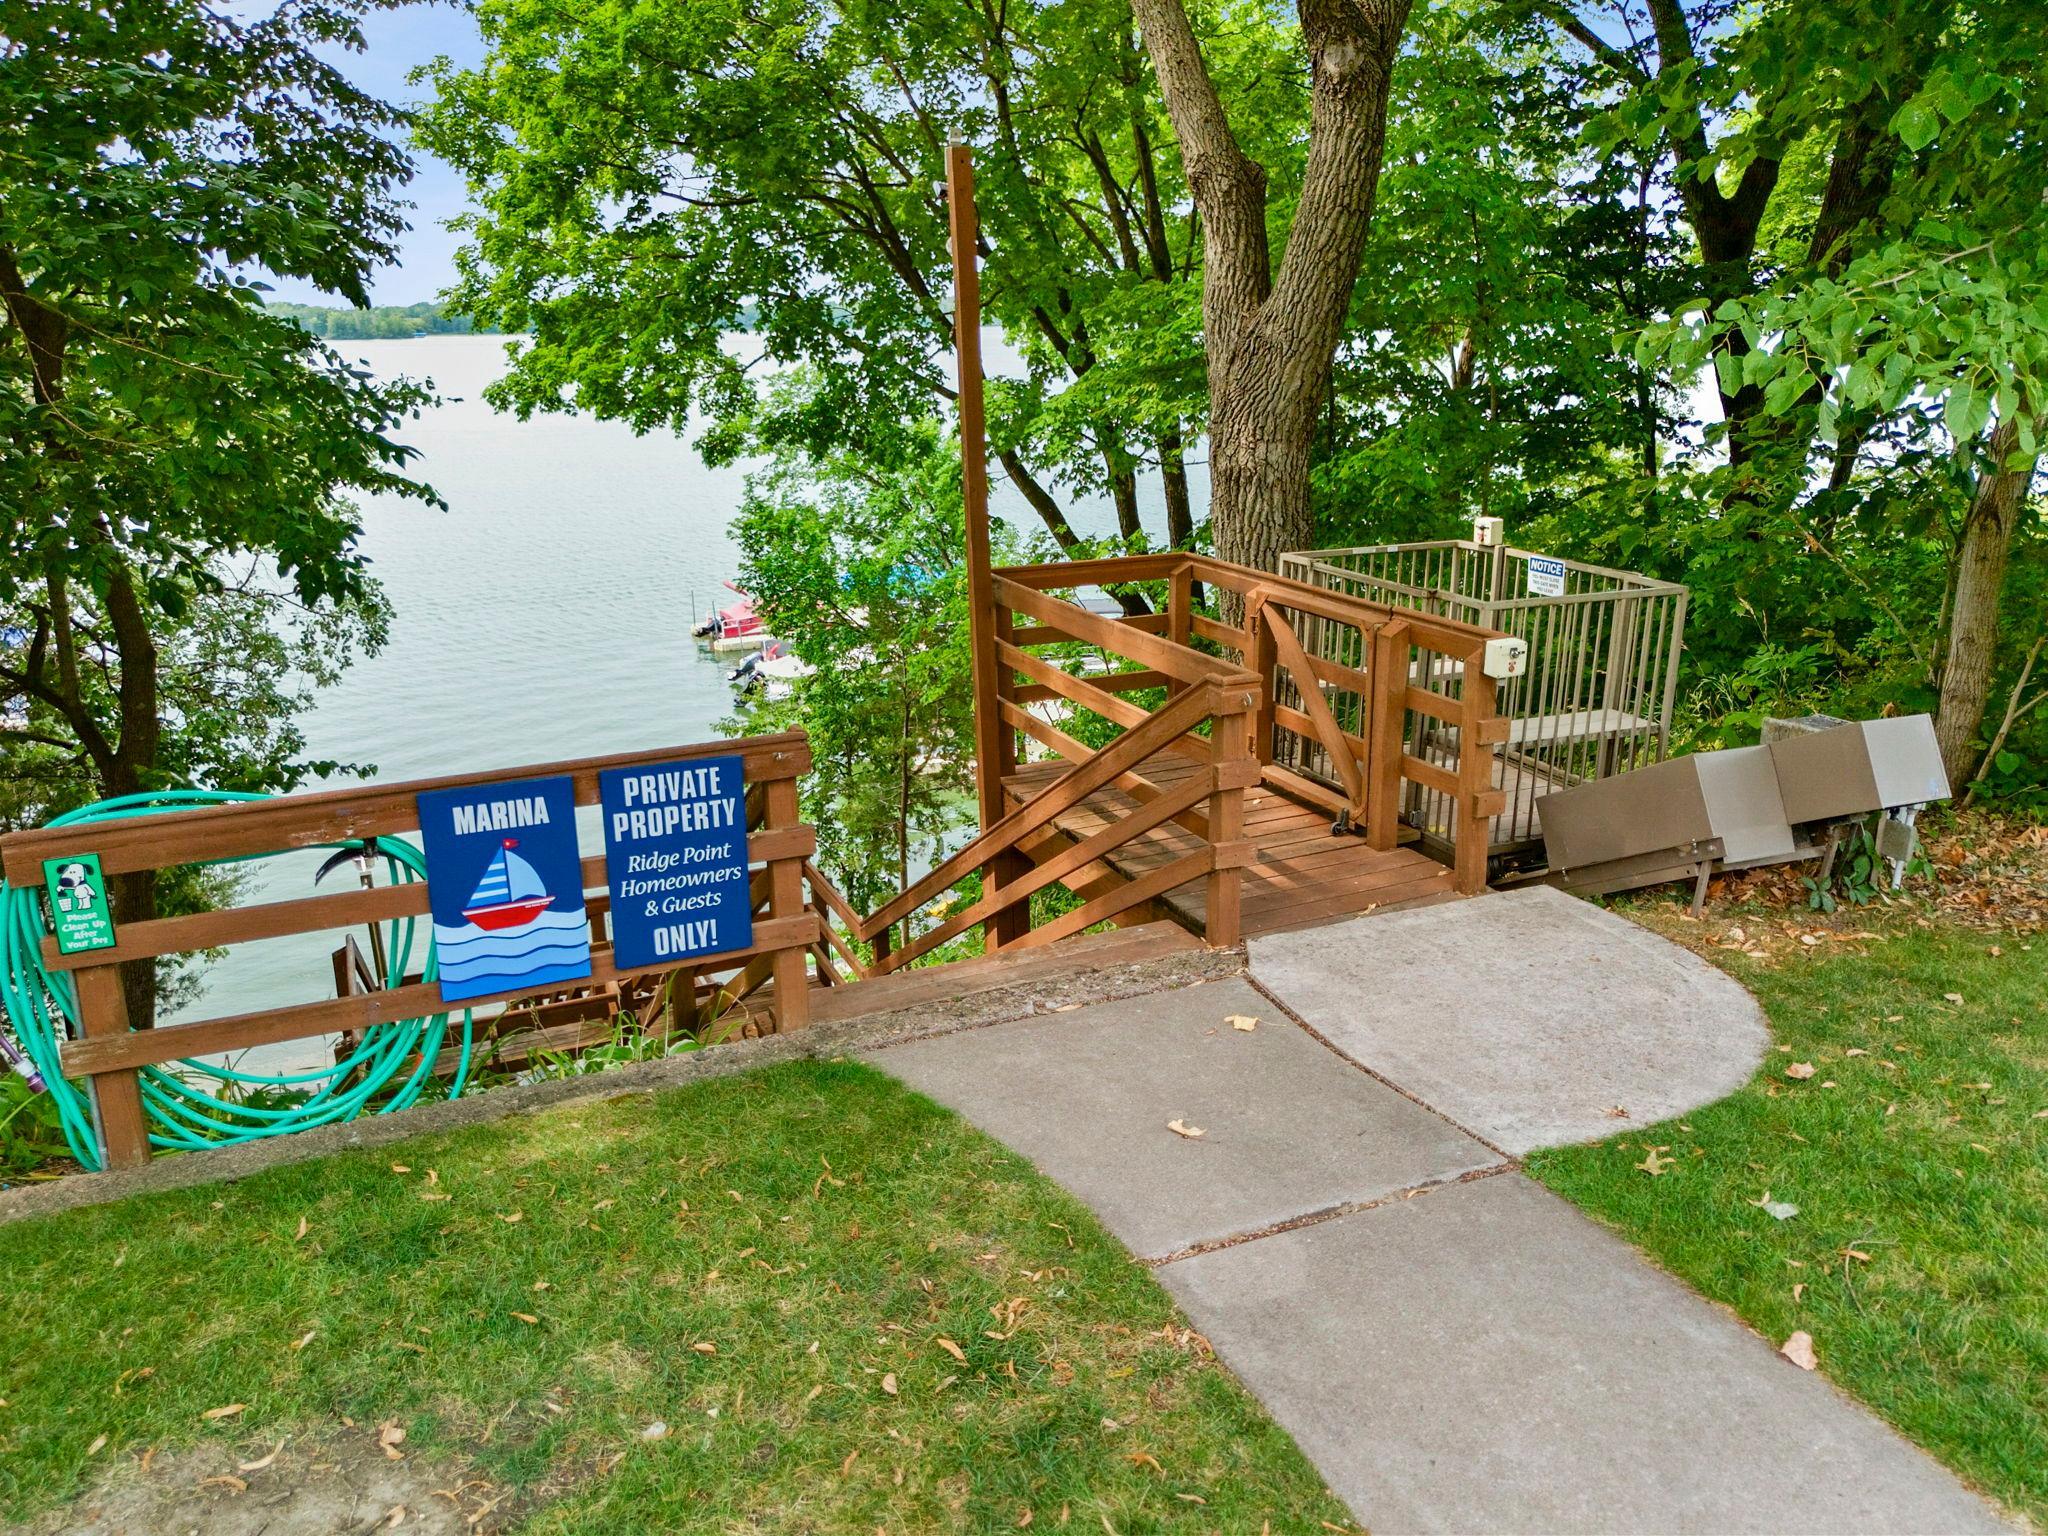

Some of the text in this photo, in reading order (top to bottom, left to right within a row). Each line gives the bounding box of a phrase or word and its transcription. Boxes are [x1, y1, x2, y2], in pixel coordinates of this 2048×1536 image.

[1531, 559, 1562, 575] NOTICE
[622, 766, 722, 807] PRIVATE
[452, 795, 550, 836] MARINA
[612, 797, 736, 842] PROPERTY
[627, 841, 731, 876] Ridge Point
[620, 864, 742, 898] Homeowners
[644, 890, 722, 917] & Guests
[61, 922, 89, 932] Clean
[74, 930, 97, 940] After
[653, 918, 719, 957] ONLY!
